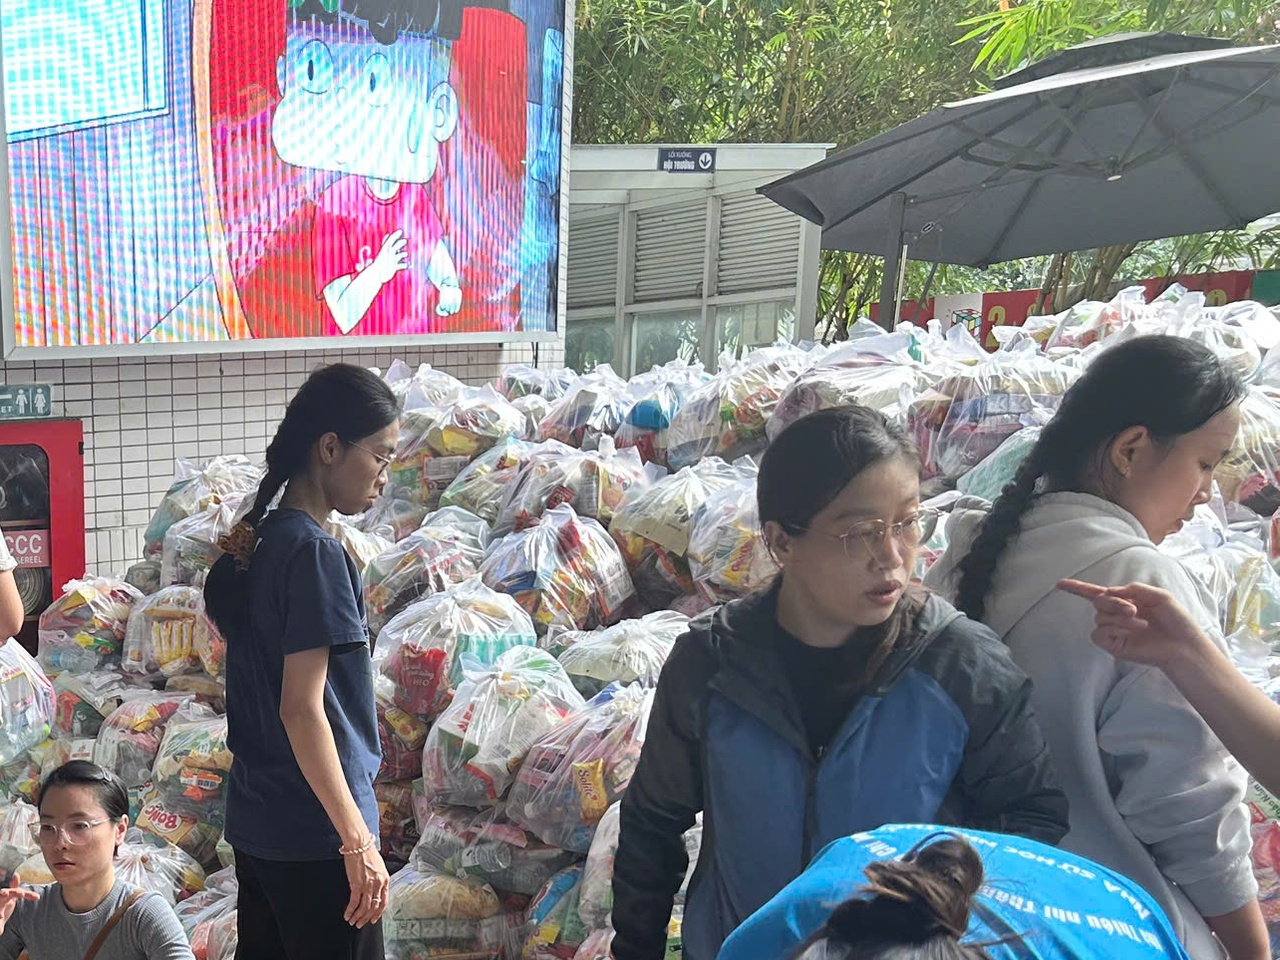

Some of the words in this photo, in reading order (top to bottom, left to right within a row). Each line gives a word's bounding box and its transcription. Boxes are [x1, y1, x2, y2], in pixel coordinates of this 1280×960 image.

[5, 534, 42, 554] CCC
[16, 555, 42, 564] SEREEL
[577, 769, 598, 801] Solite
[1043, 904, 1082, 926] nhi
